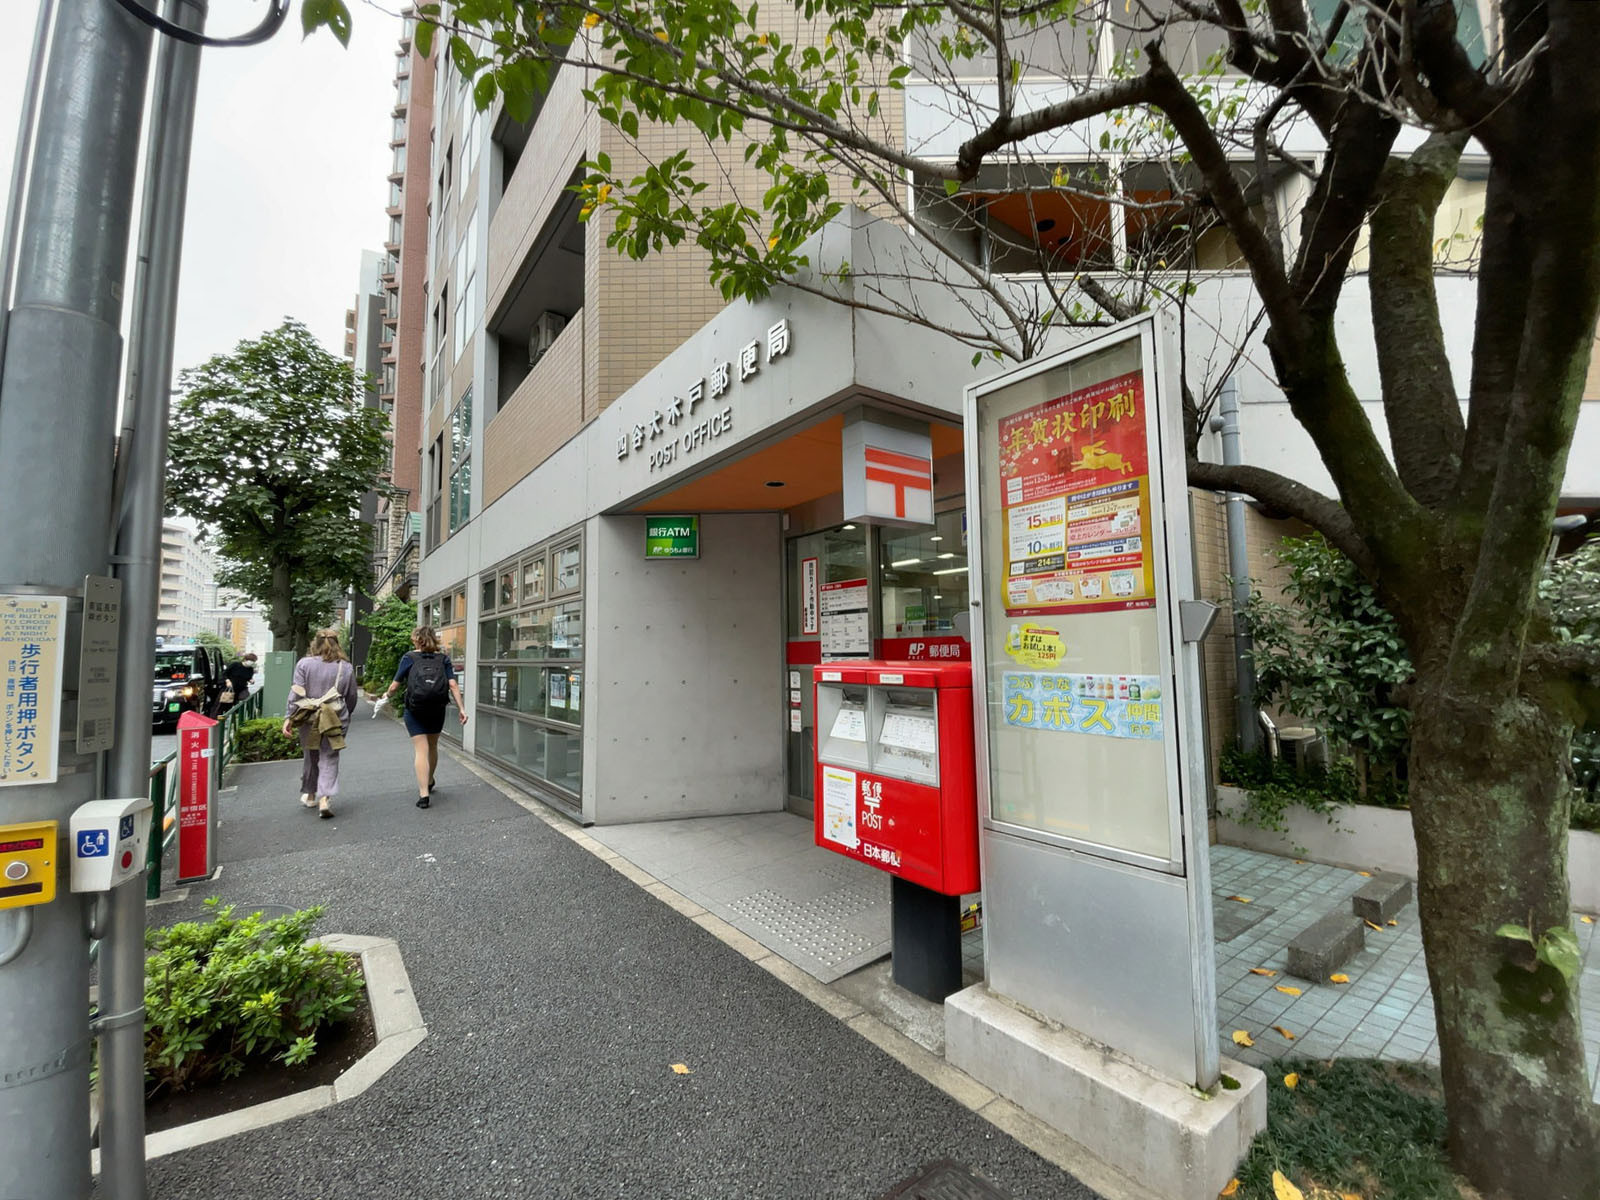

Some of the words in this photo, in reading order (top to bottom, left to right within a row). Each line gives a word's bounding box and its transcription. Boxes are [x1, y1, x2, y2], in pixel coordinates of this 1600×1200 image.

[615, 317, 792, 462] 四谷大木戸郵便局
[1006, 388, 1137, 453] 年賀状印刷
[649, 438, 680, 474] POST
[682, 406, 734, 454] OFFICE
[649, 527, 690, 537] 銀行ATM
[1023, 634, 1042, 643] まずは
[929, 644, 960, 658] 郵便局
[1007, 676, 1070, 691] つぶらな
[16, 643, 41, 773] 歩行者用押ボタン
[1008, 693, 1114, 731] カボス
[1126, 702, 1160, 723] 仲間
[190, 731, 200, 758] 消火器
[862, 779, 882, 800] 郵便
[862, 810, 883, 831] POST
[863, 842, 901, 867] 日本郵便
